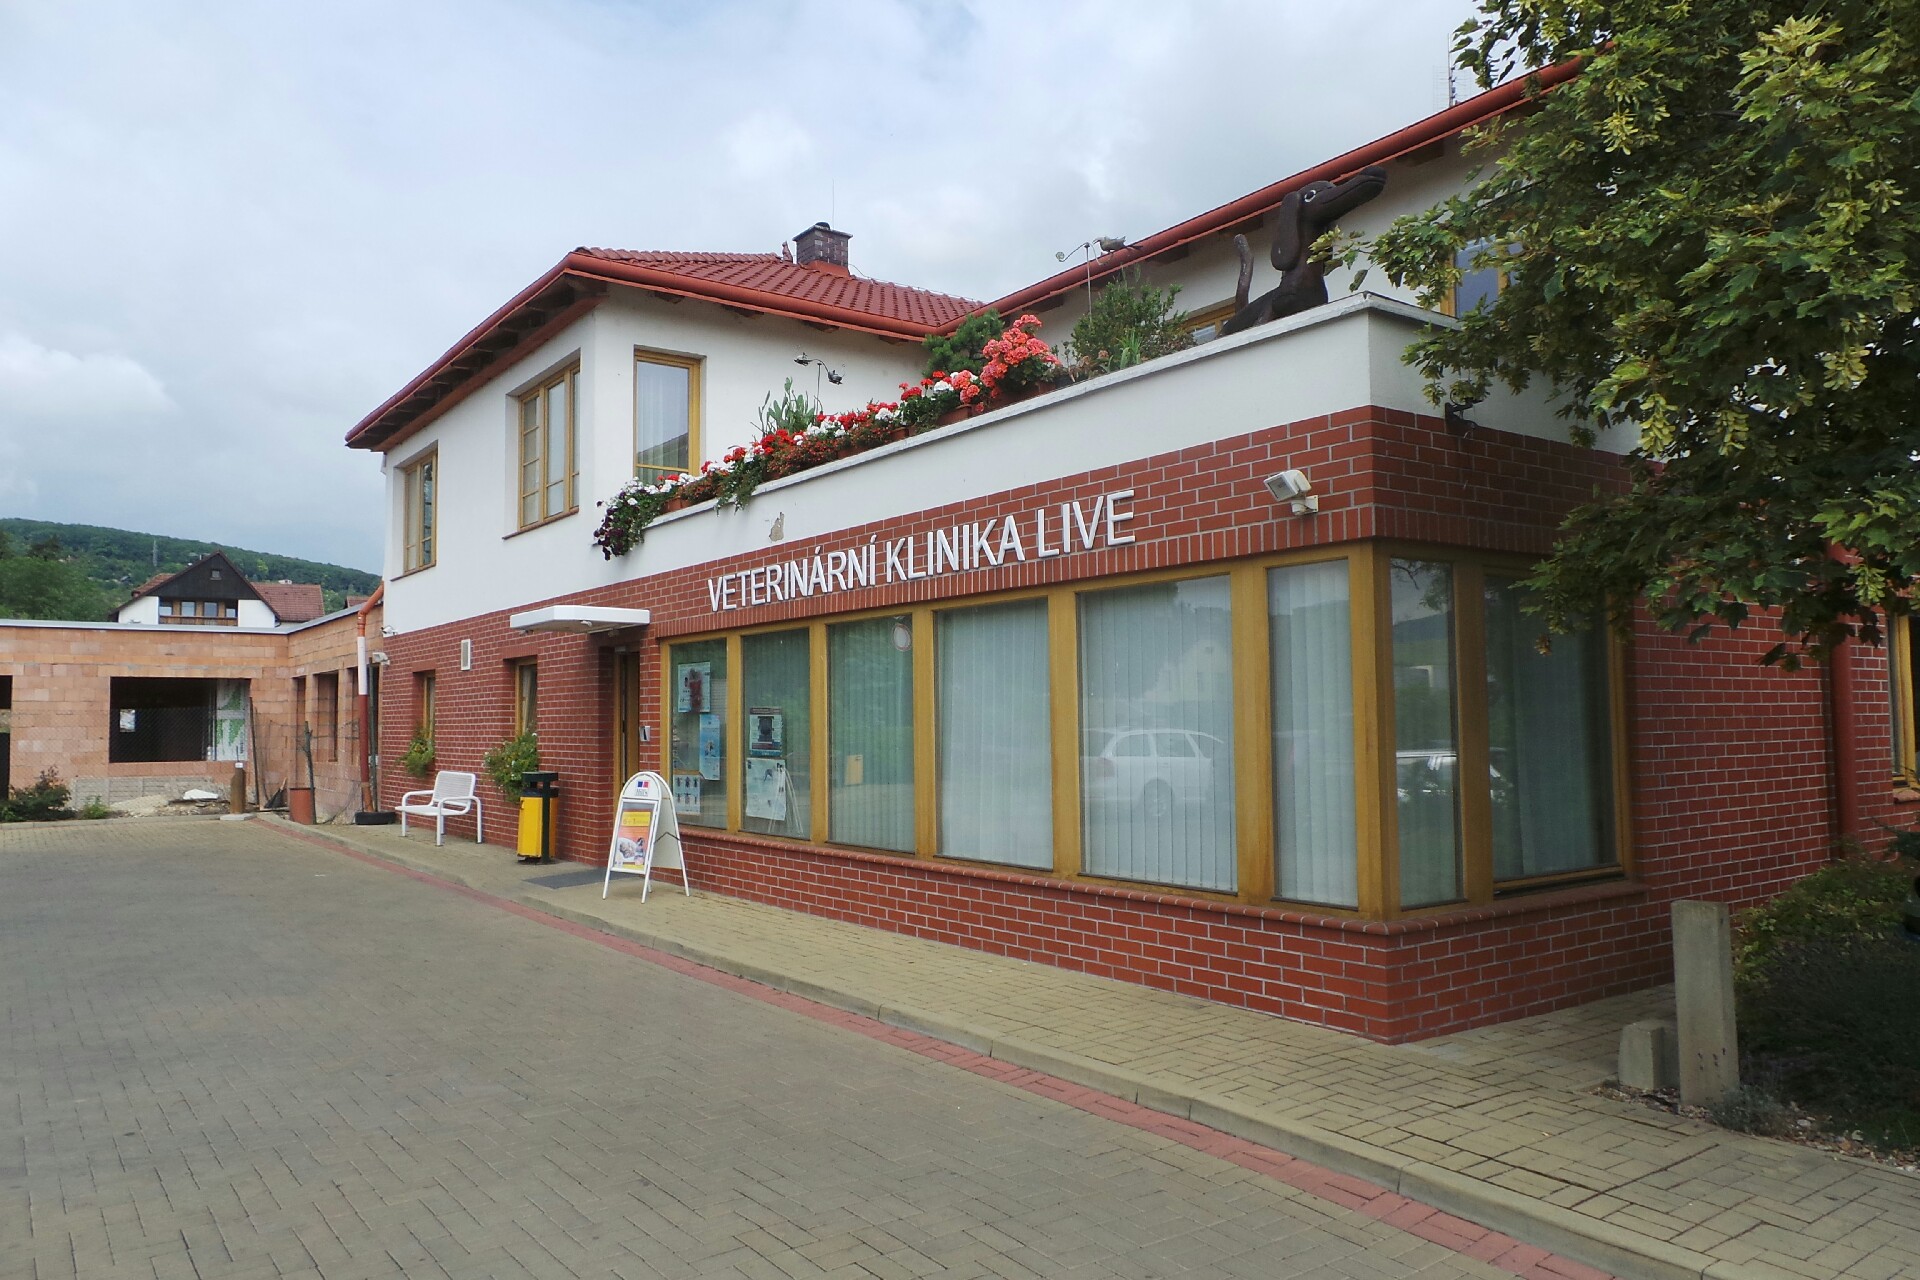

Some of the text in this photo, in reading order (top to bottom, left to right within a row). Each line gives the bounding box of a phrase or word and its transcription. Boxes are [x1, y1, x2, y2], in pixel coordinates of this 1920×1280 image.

[708, 490, 1136, 612] VETERINÁRNÍ KLINIKA LIVE
